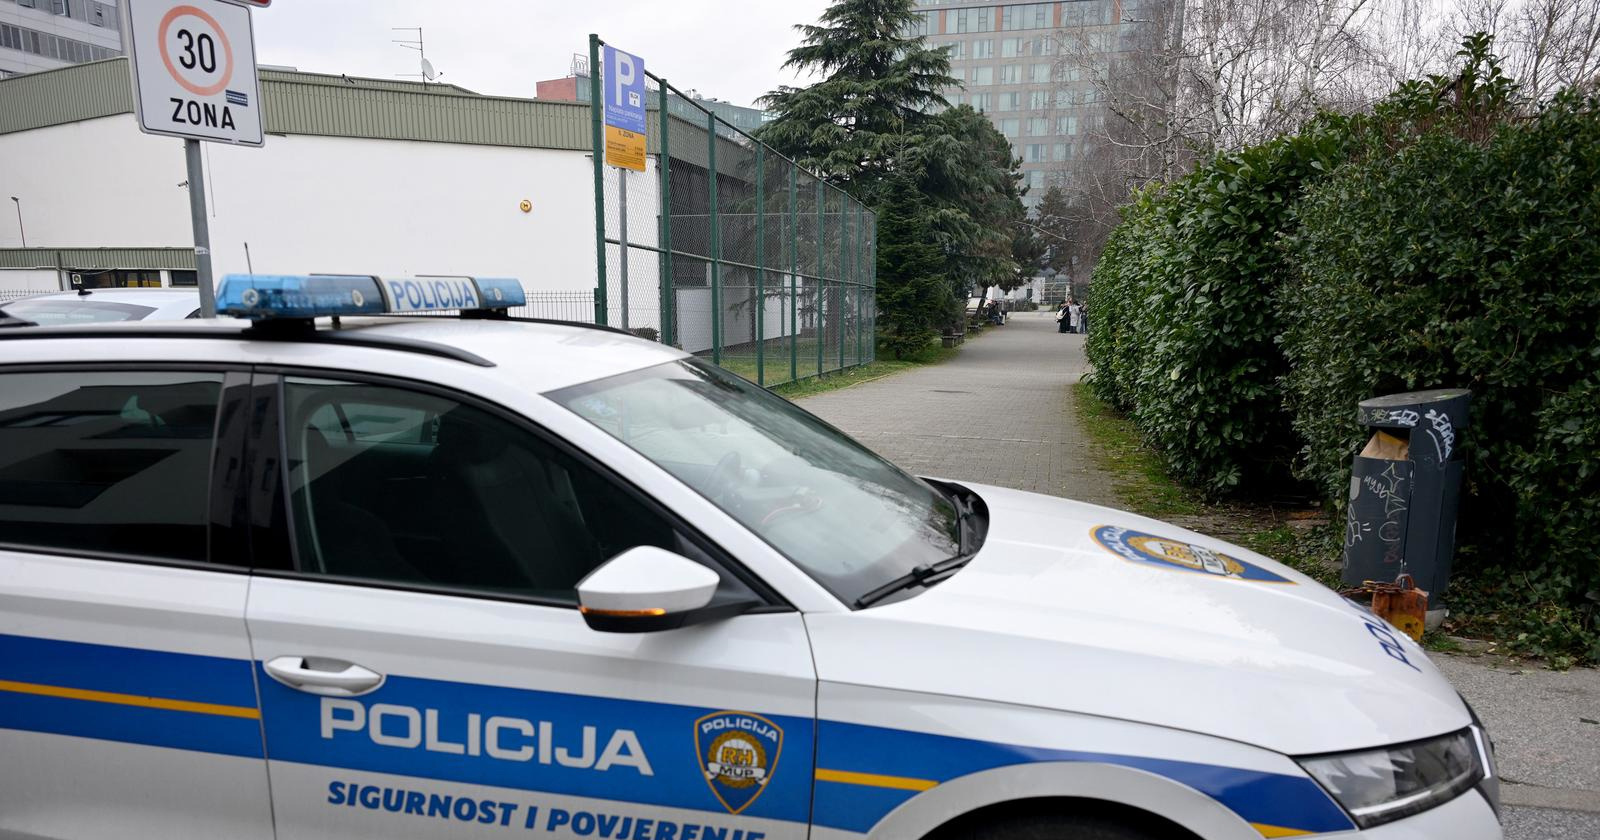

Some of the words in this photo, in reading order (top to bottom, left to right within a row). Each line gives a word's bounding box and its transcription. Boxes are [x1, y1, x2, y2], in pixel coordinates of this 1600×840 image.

[177, 28, 216, 73] 30
[170, 97, 236, 130] ZONA
[389, 280, 475, 310] POLICIJA
[320, 697, 654, 777] POLICIJA
[702, 718, 777, 742] POLICIJA
[720, 766, 754, 778] MUP
[722, 747, 754, 767] RH
[328, 781, 518, 827] SIGURNOST
[525, 806, 538, 829] I
